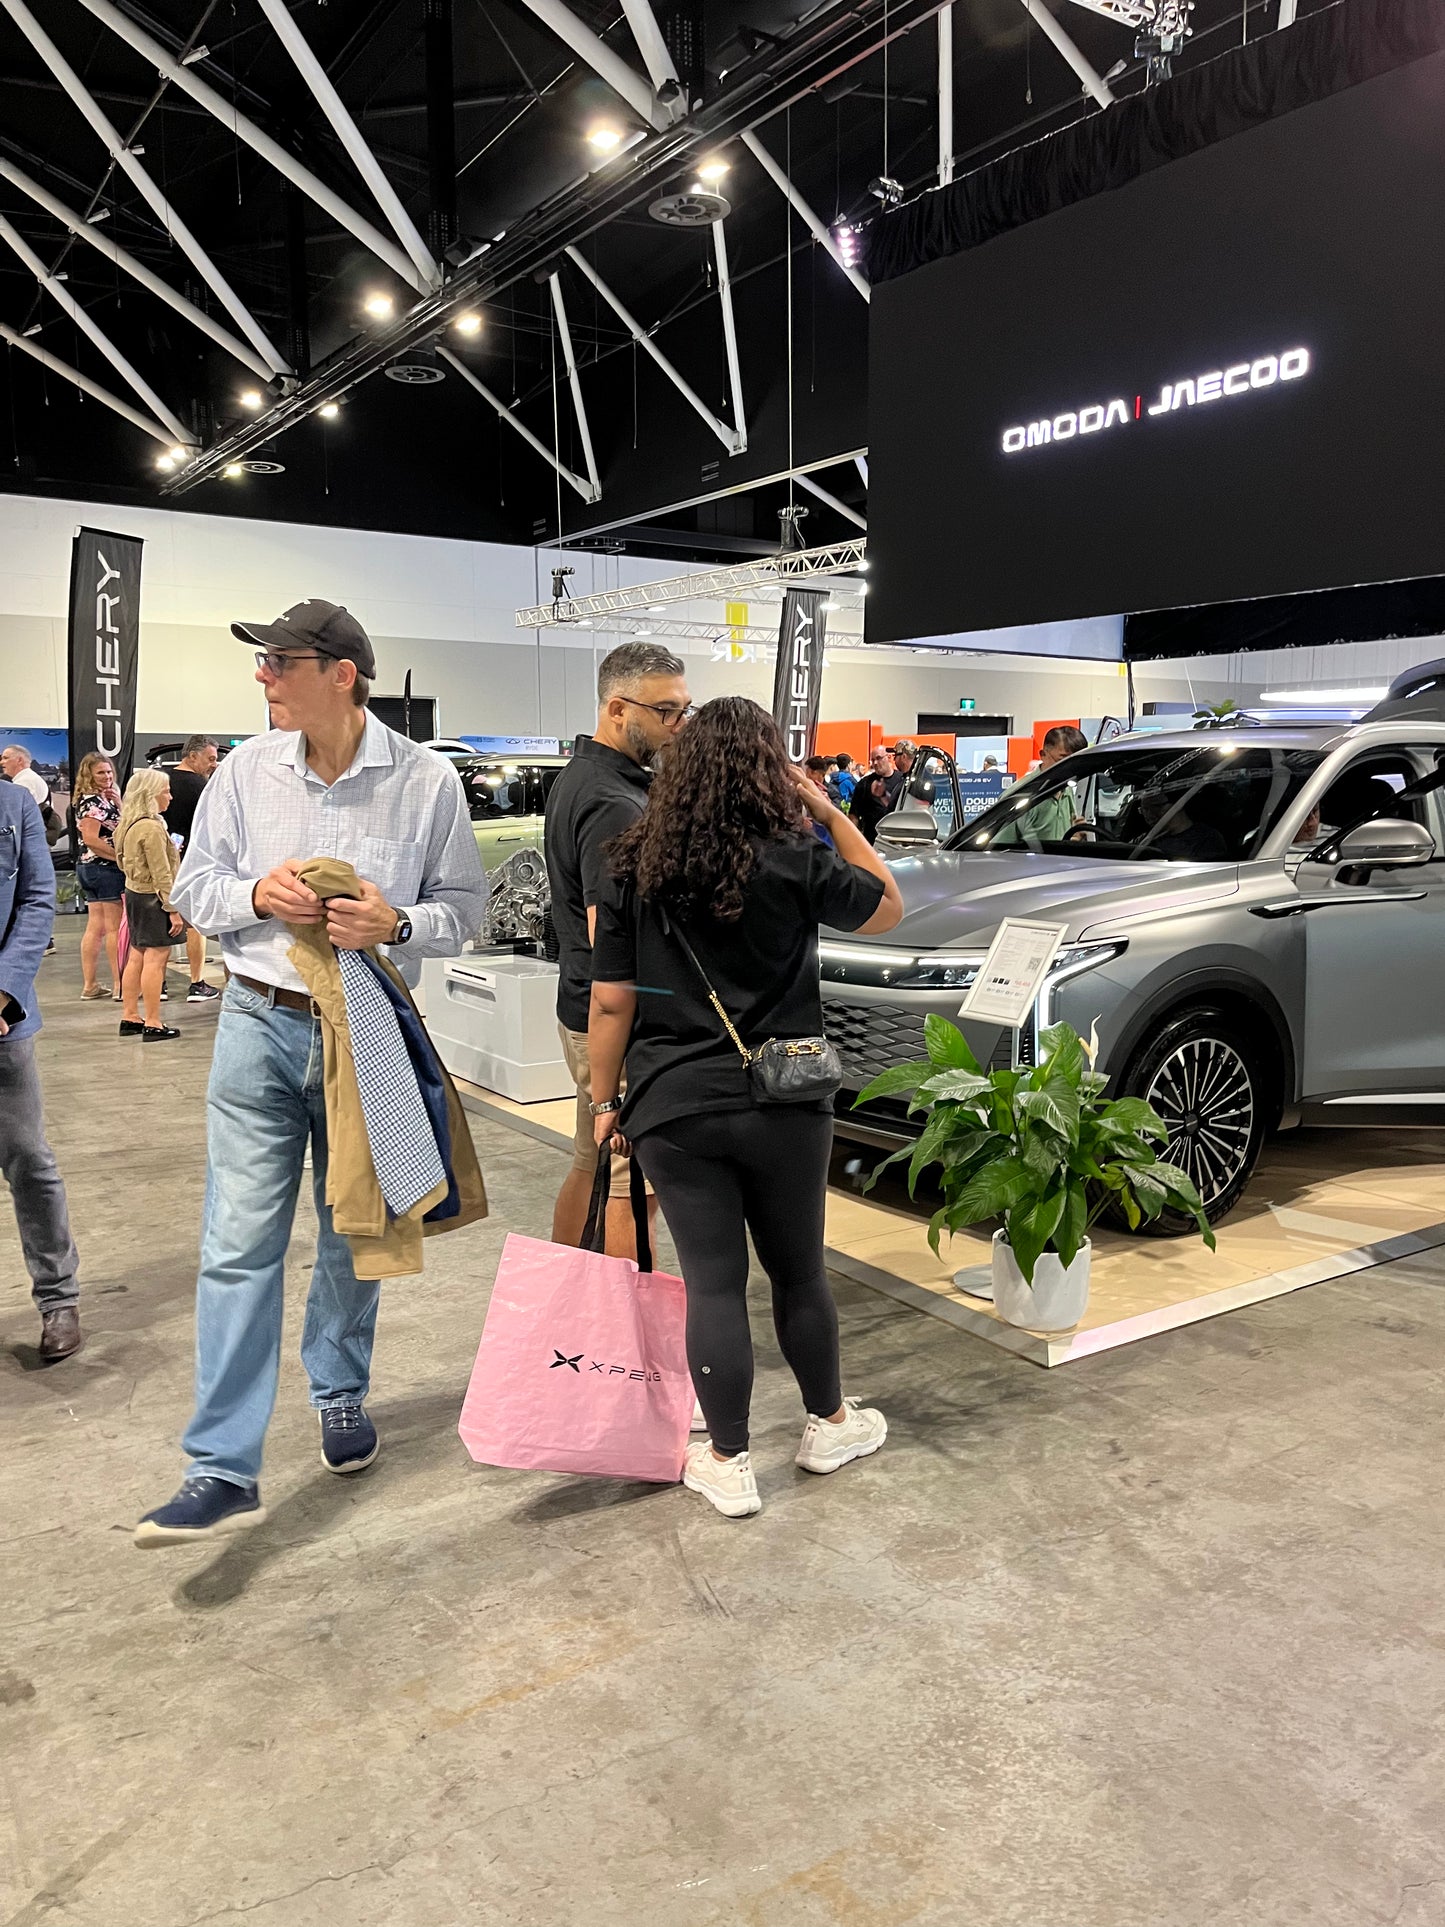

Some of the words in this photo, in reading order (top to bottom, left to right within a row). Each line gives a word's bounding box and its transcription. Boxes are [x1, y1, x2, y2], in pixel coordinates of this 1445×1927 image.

[1002, 399, 1128, 453] OMODA
[1148, 348, 1310, 415] JAECOO
[96, 551, 122, 758] CHERY
[788, 604, 814, 762] CHERY
